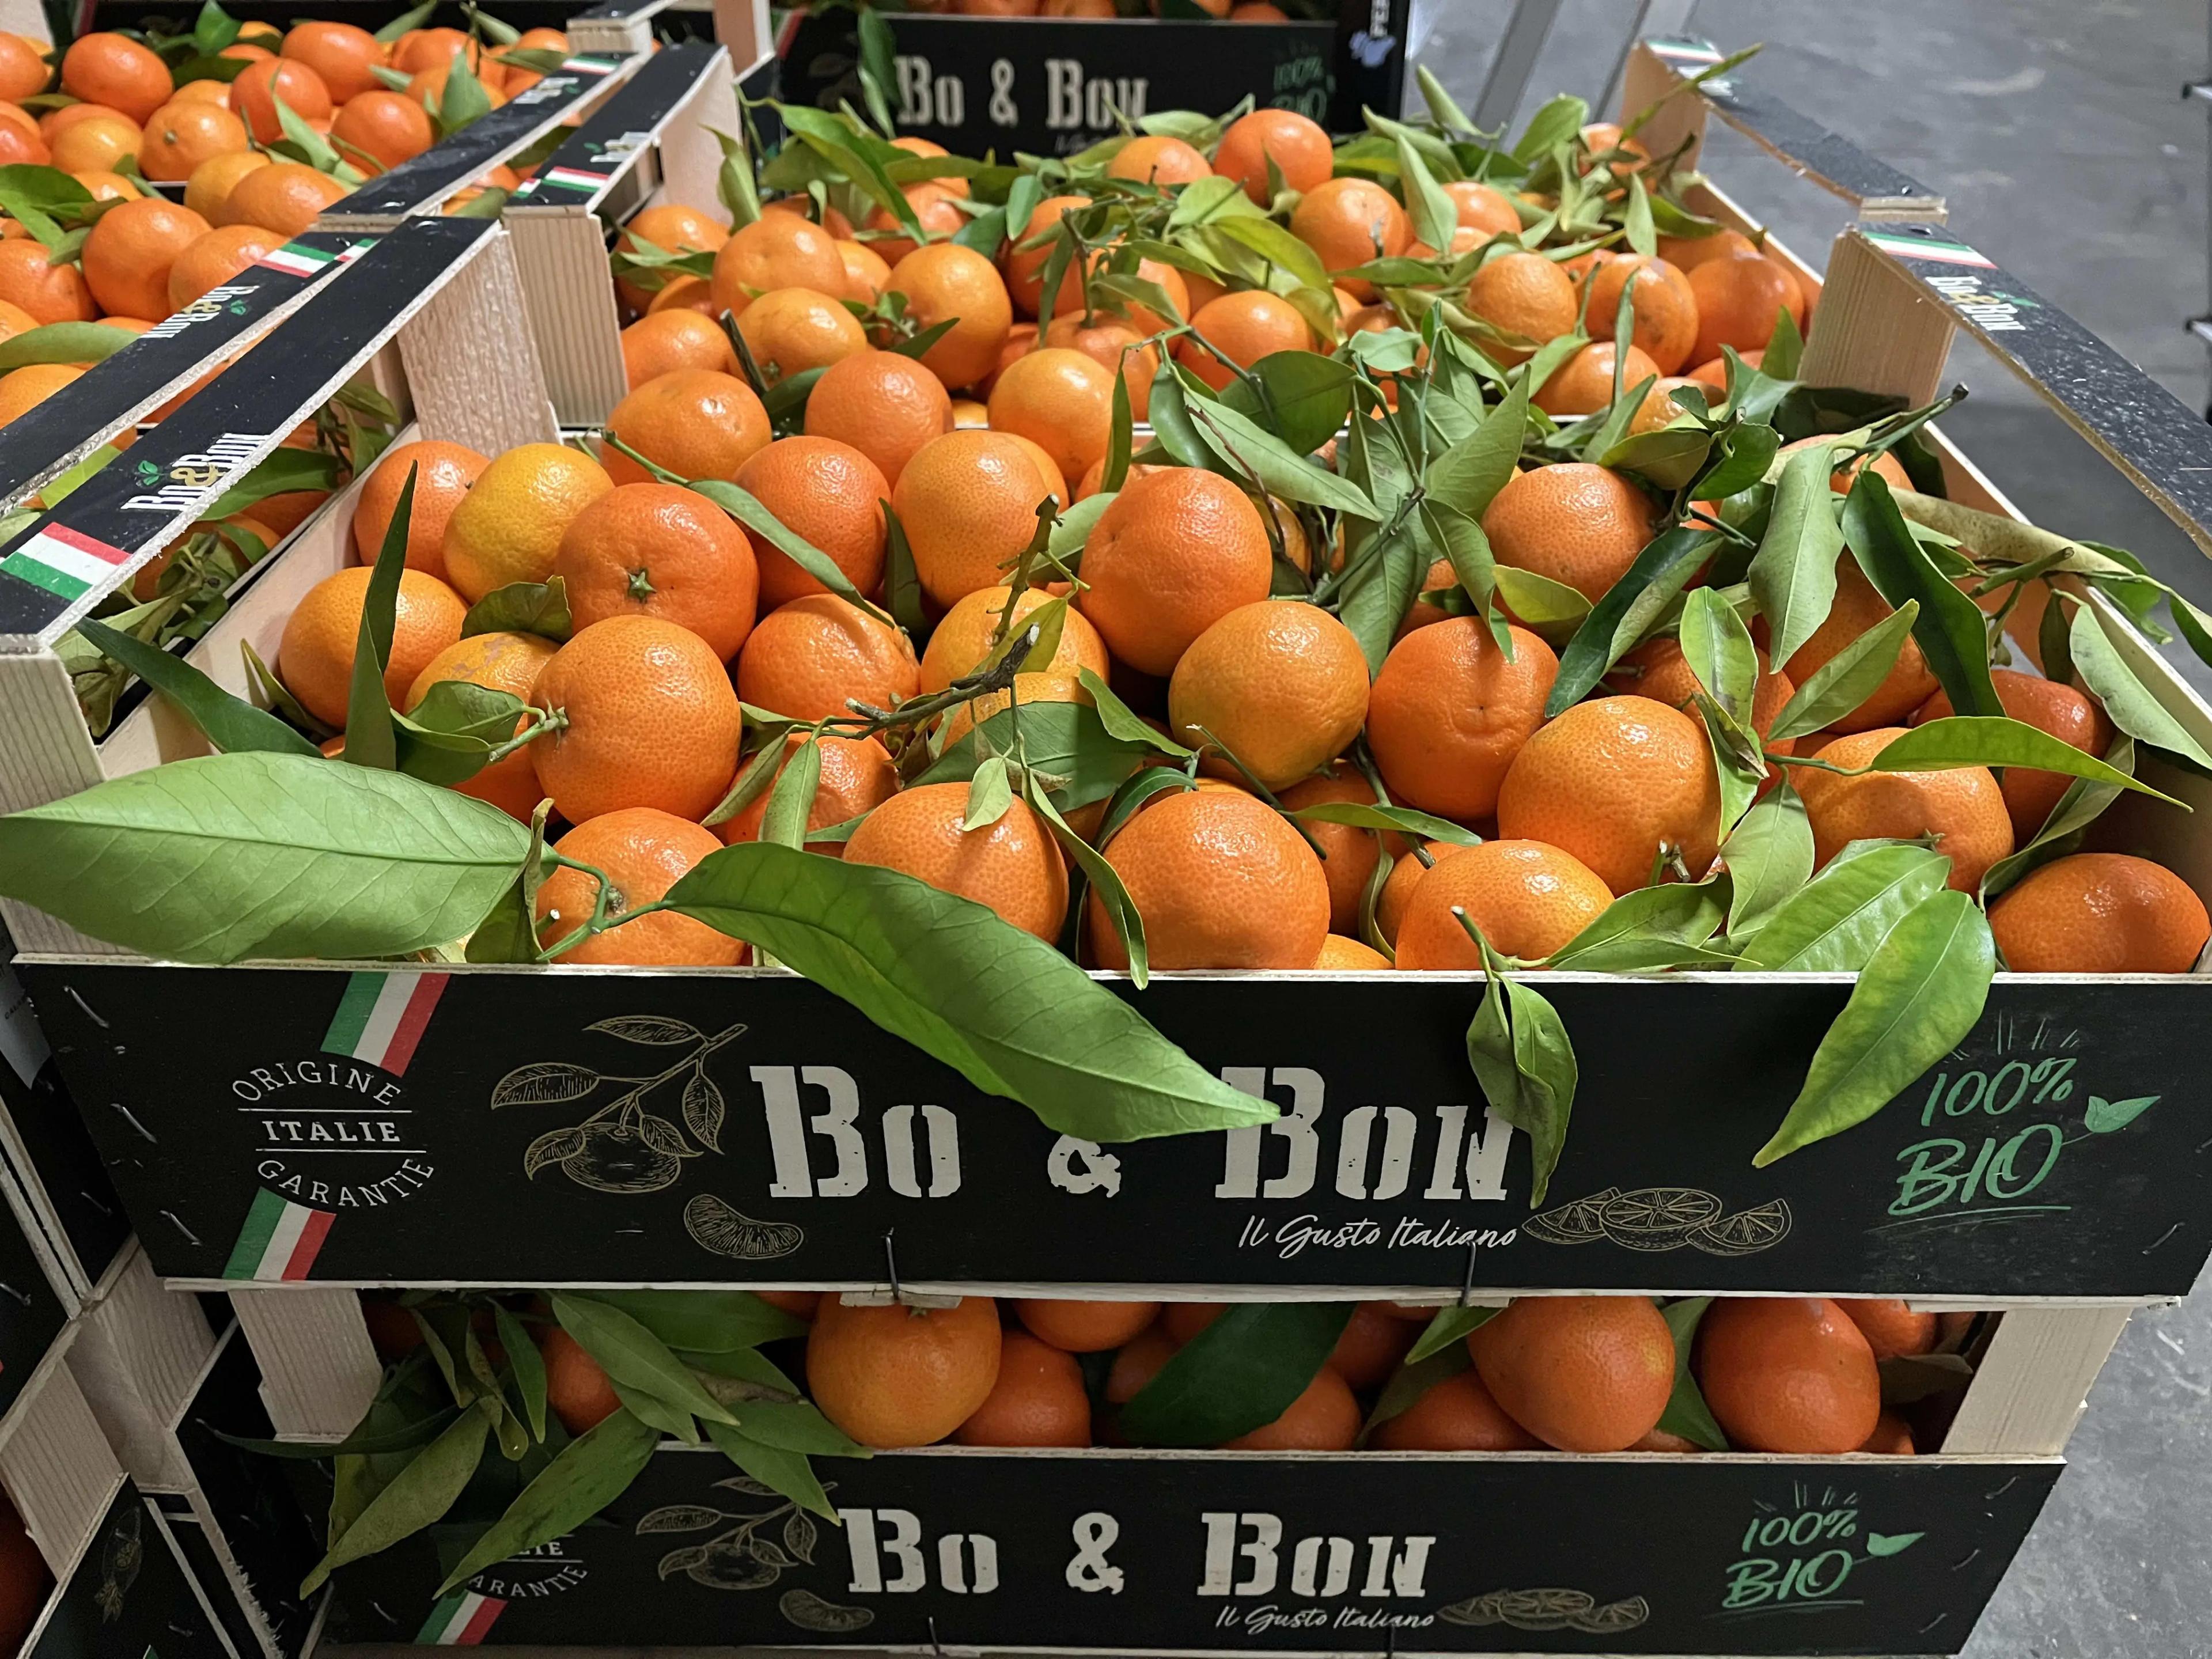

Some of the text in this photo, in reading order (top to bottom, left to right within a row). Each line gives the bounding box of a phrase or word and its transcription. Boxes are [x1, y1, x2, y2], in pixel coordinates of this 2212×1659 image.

[989, 58, 1019, 127] &
[232, 1061, 402, 1105] ORIGINE
[1921, 1057, 2077, 1127] 100%
[262, 1120, 400, 1142] ITALIE
[257, 1158, 434, 1207] GARANTIE
[1887, 1123, 2063, 1215] BIO
[1238, 1214, 1518, 1259] Il Gusto Italiano
[1066, 1512, 1124, 1595] &
[1741, 1509, 1858, 1553] 100%
[468, 1565, 589, 1597] ARANTIE
[1721, 1549, 1853, 1608] BIO
[1215, 1604, 1435, 1635] Il Gusto Italiano
